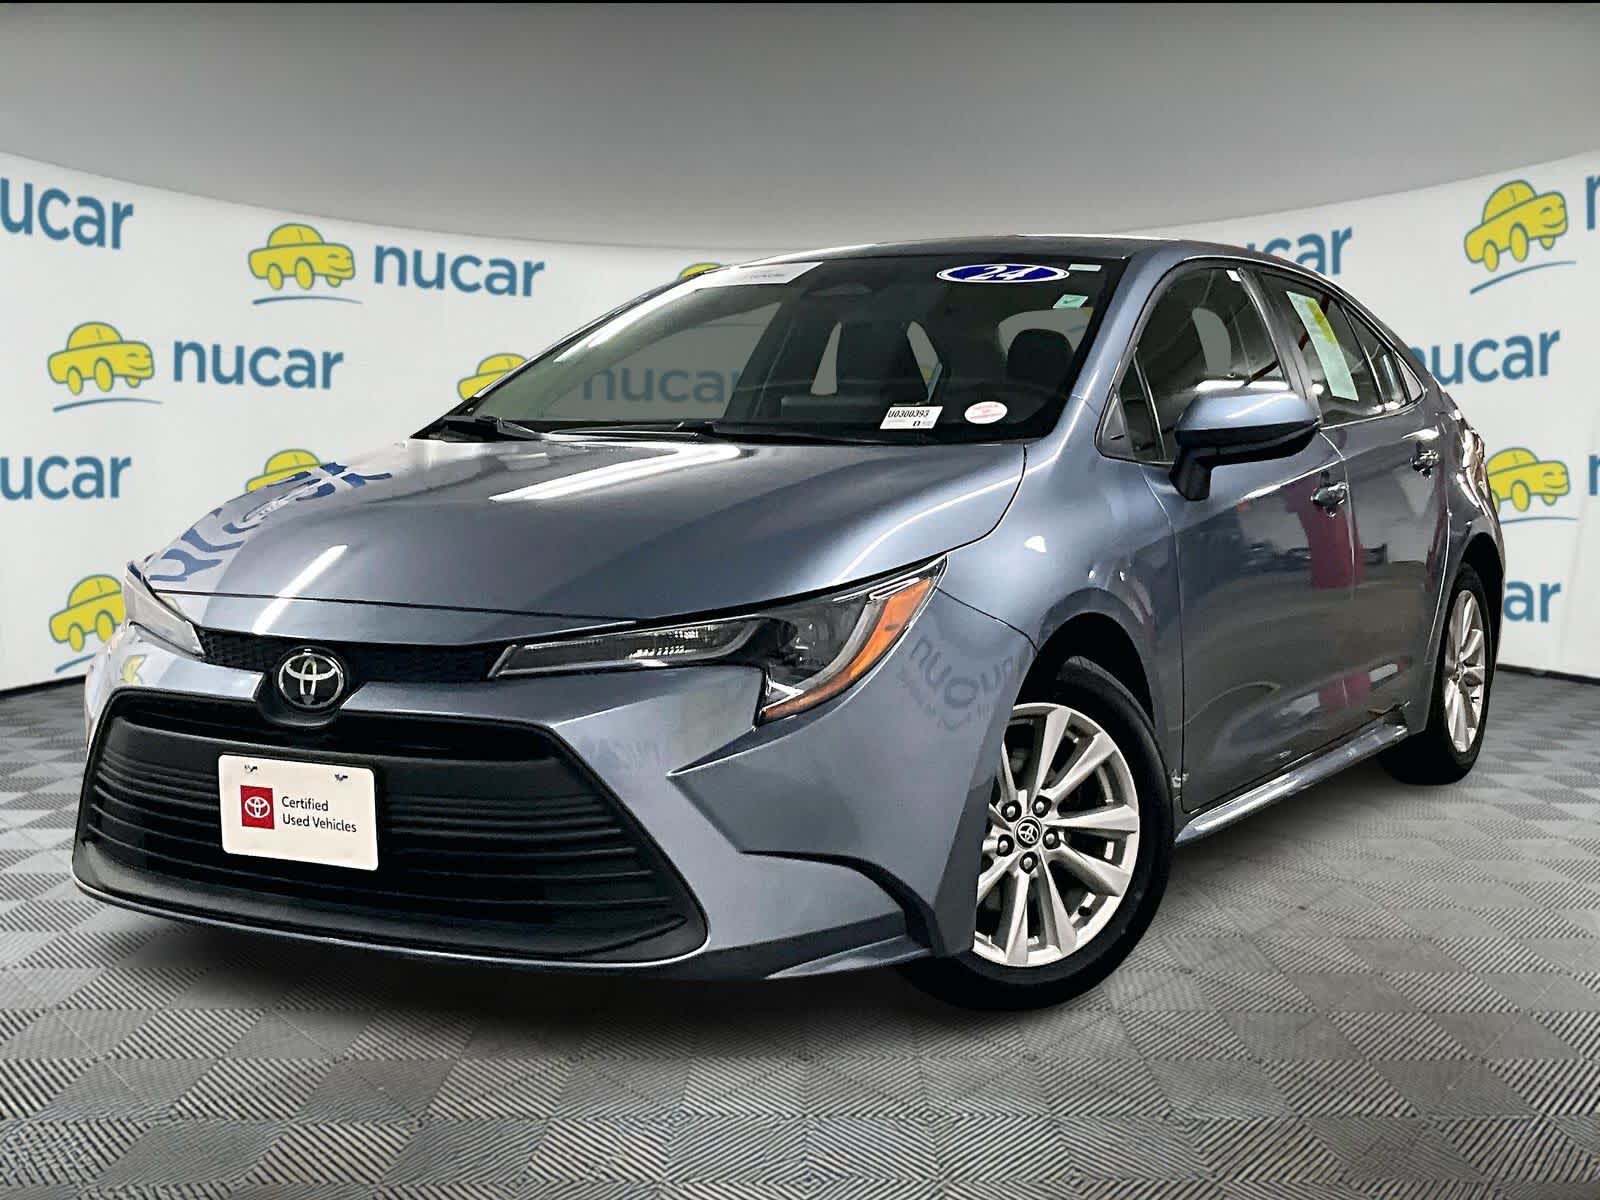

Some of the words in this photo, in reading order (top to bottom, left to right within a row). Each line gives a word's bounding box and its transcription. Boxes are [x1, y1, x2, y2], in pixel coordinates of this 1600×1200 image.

[374, 244, 545, 297] nucar
[964, 265, 1040, 281] 24
[173, 340, 344, 390] nucar
[281, 795, 329, 812] Certified
[282, 813, 310, 827] Used
[312, 817, 357, 833] Vehicles
